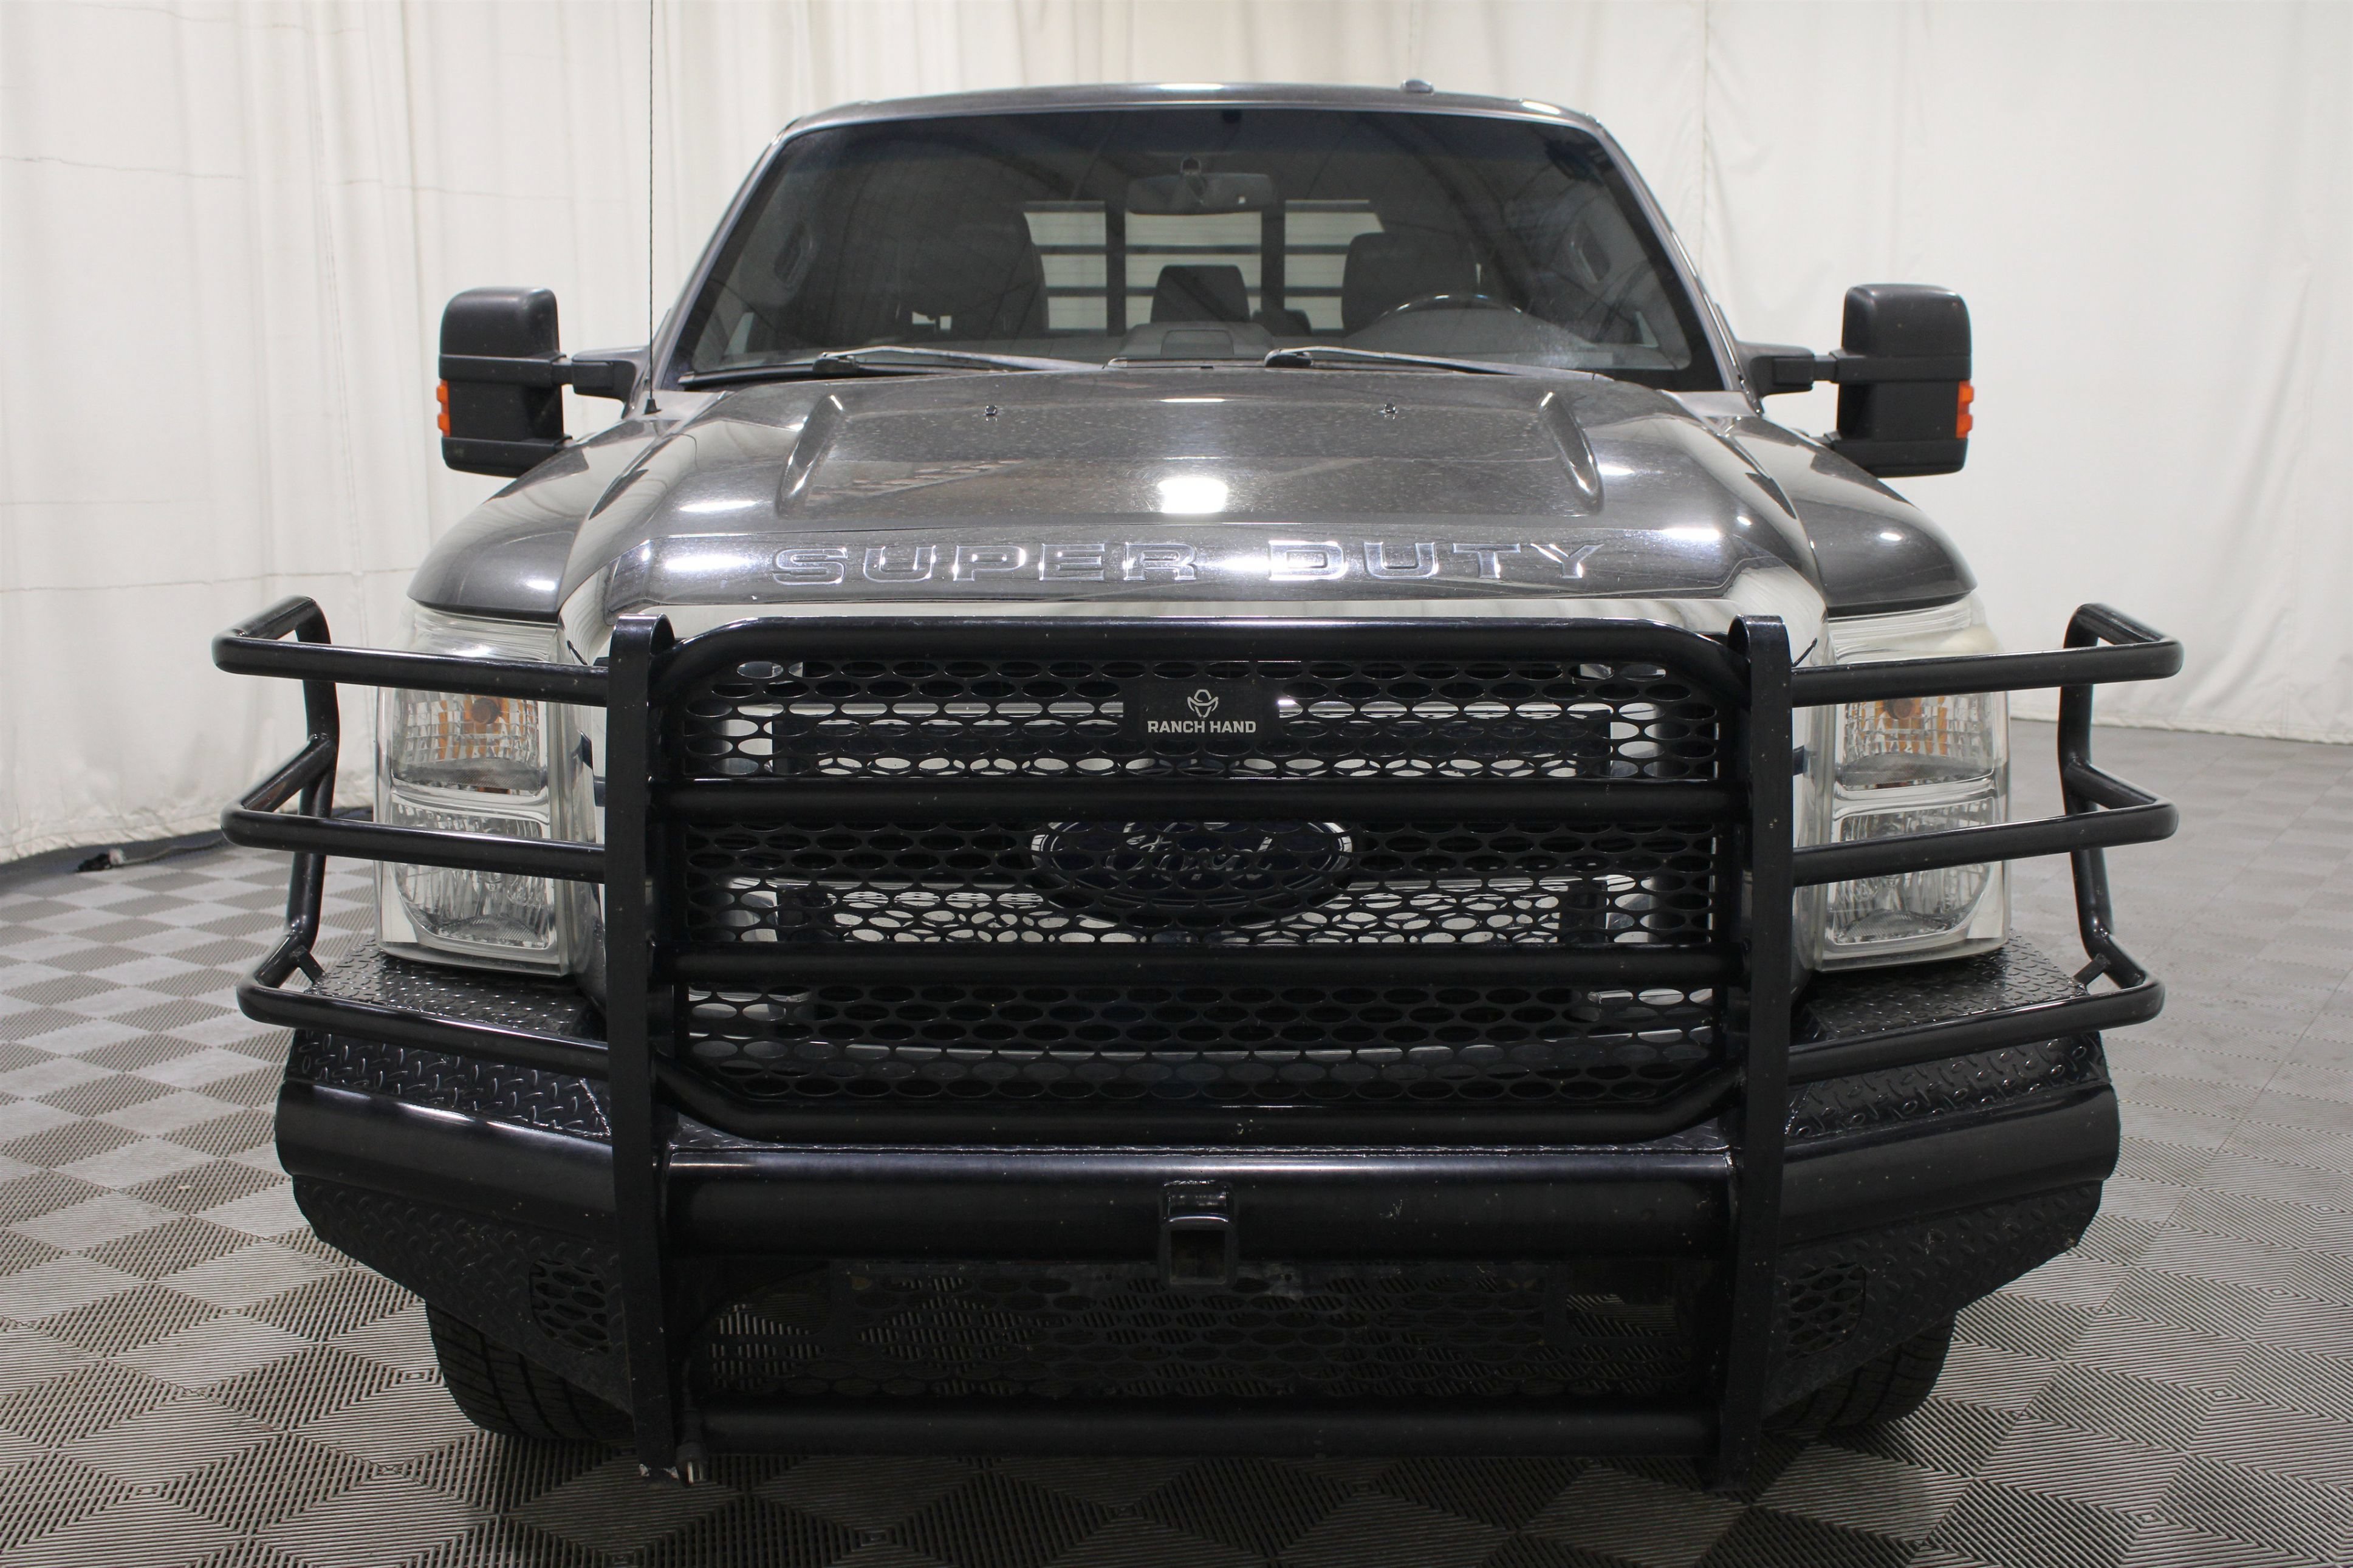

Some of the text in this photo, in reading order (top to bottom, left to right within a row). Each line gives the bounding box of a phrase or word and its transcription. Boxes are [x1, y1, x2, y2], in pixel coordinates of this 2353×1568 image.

[772, 540, 1605, 585] SUPER DUTY
[1147, 721, 1256, 733] RANCH HAND
